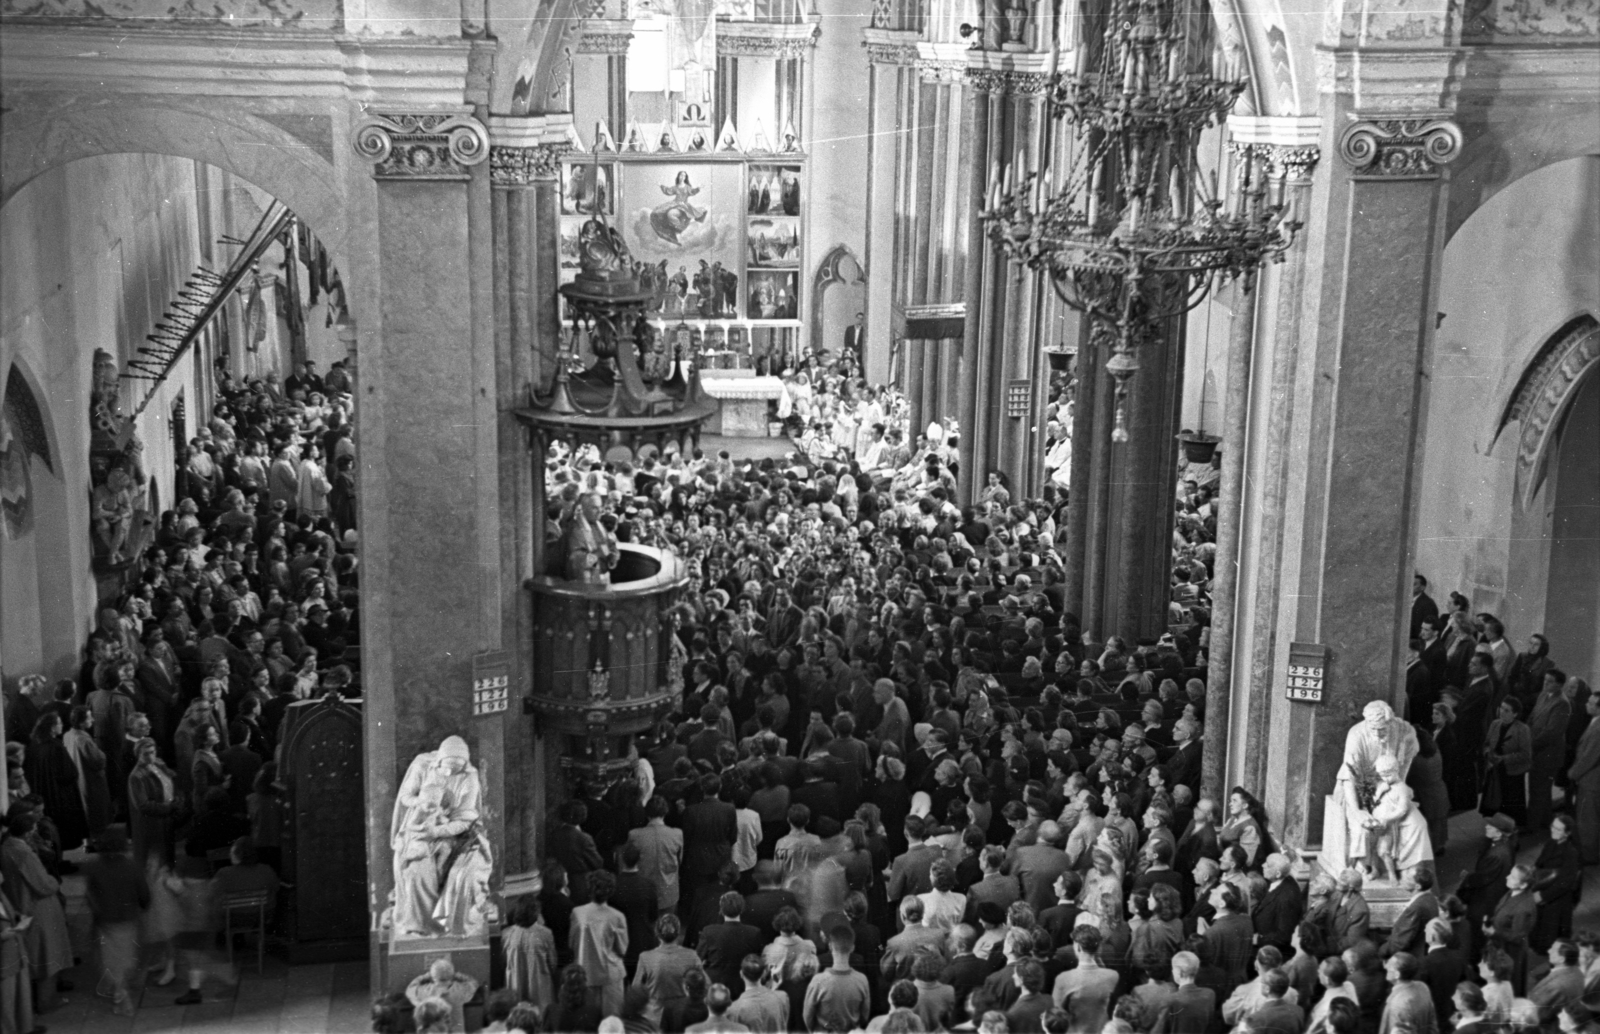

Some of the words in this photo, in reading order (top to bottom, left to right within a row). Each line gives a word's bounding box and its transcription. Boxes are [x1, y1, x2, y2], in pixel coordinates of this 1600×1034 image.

[682, 103, 706, 121] Ω
[1291, 665, 1321, 677] 226
[477, 675, 506, 689] 226
[1292, 676, 1321, 688] 127
[478, 688, 505, 702] 127
[1291, 688, 1319, 699] 196
[478, 699, 505, 714] 196
